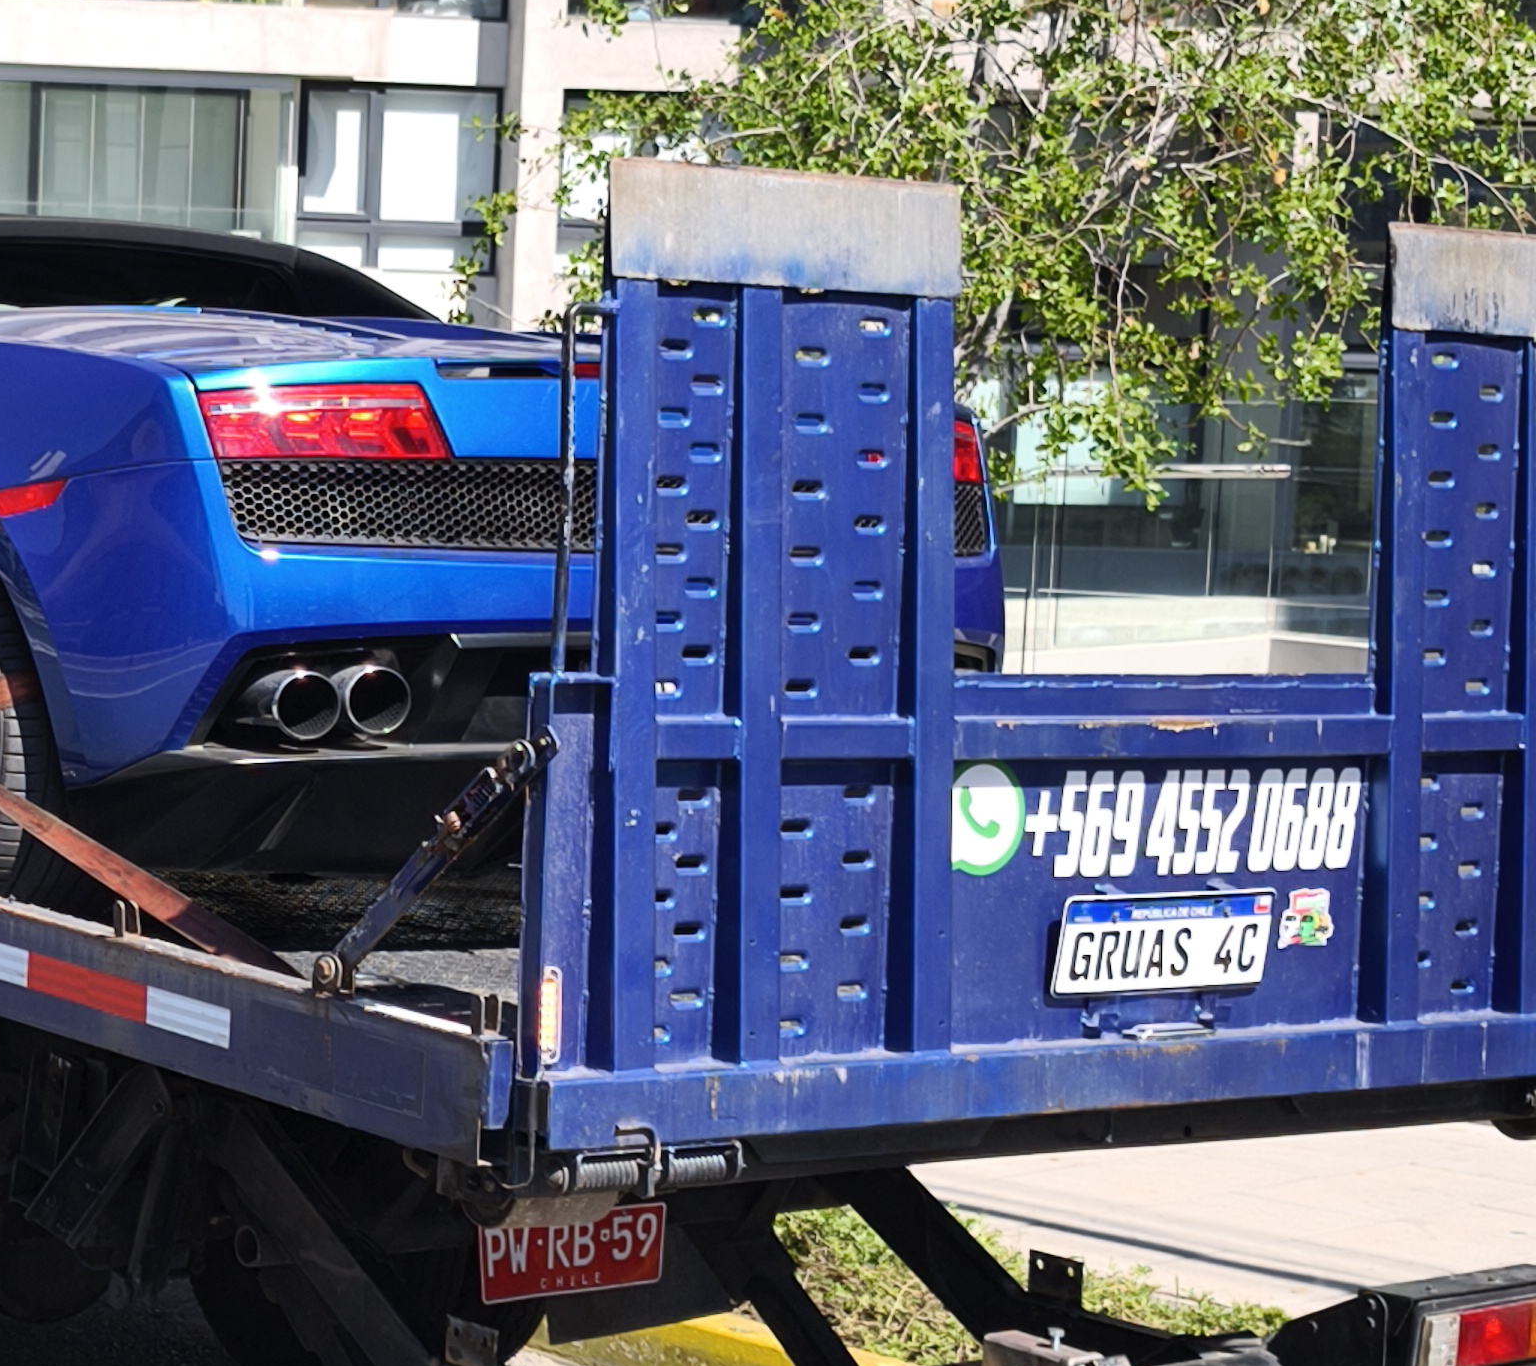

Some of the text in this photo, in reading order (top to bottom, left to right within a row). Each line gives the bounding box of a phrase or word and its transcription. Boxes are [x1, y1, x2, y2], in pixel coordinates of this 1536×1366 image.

[1145, 769, 1251, 876] 4552
[1247, 767, 1361, 872] 0688
[1069, 923, 1259, 981] GRUAS 4C
[540, 1271, 602, 1289] CHILE
